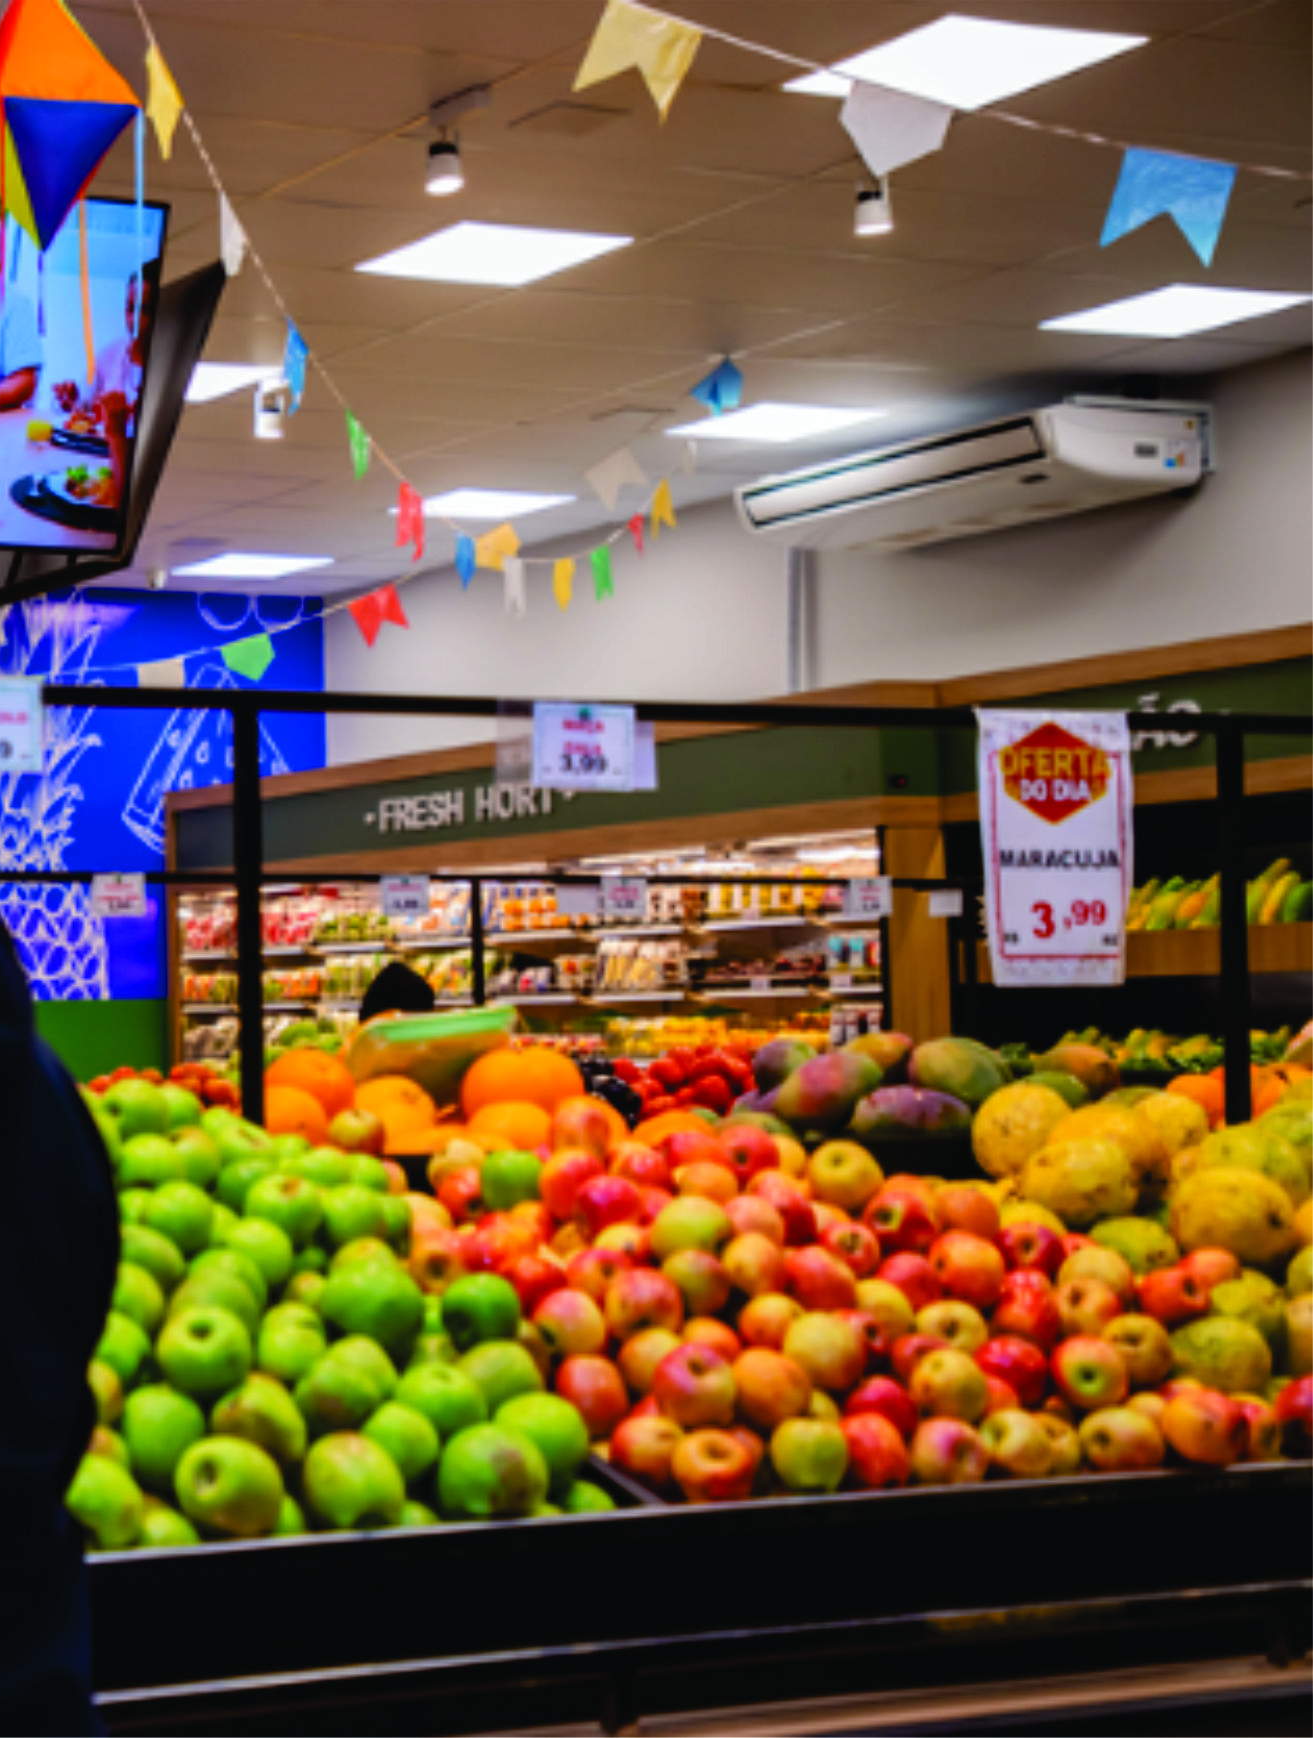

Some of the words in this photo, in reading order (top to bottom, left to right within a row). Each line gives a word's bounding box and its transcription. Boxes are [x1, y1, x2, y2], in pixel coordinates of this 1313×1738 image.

[998, 746, 1112, 778] OFERTA
[1019, 779, 1047, 801] DO
[1052, 779, 1090, 802] DIA
[379, 789, 464, 832] FRESH
